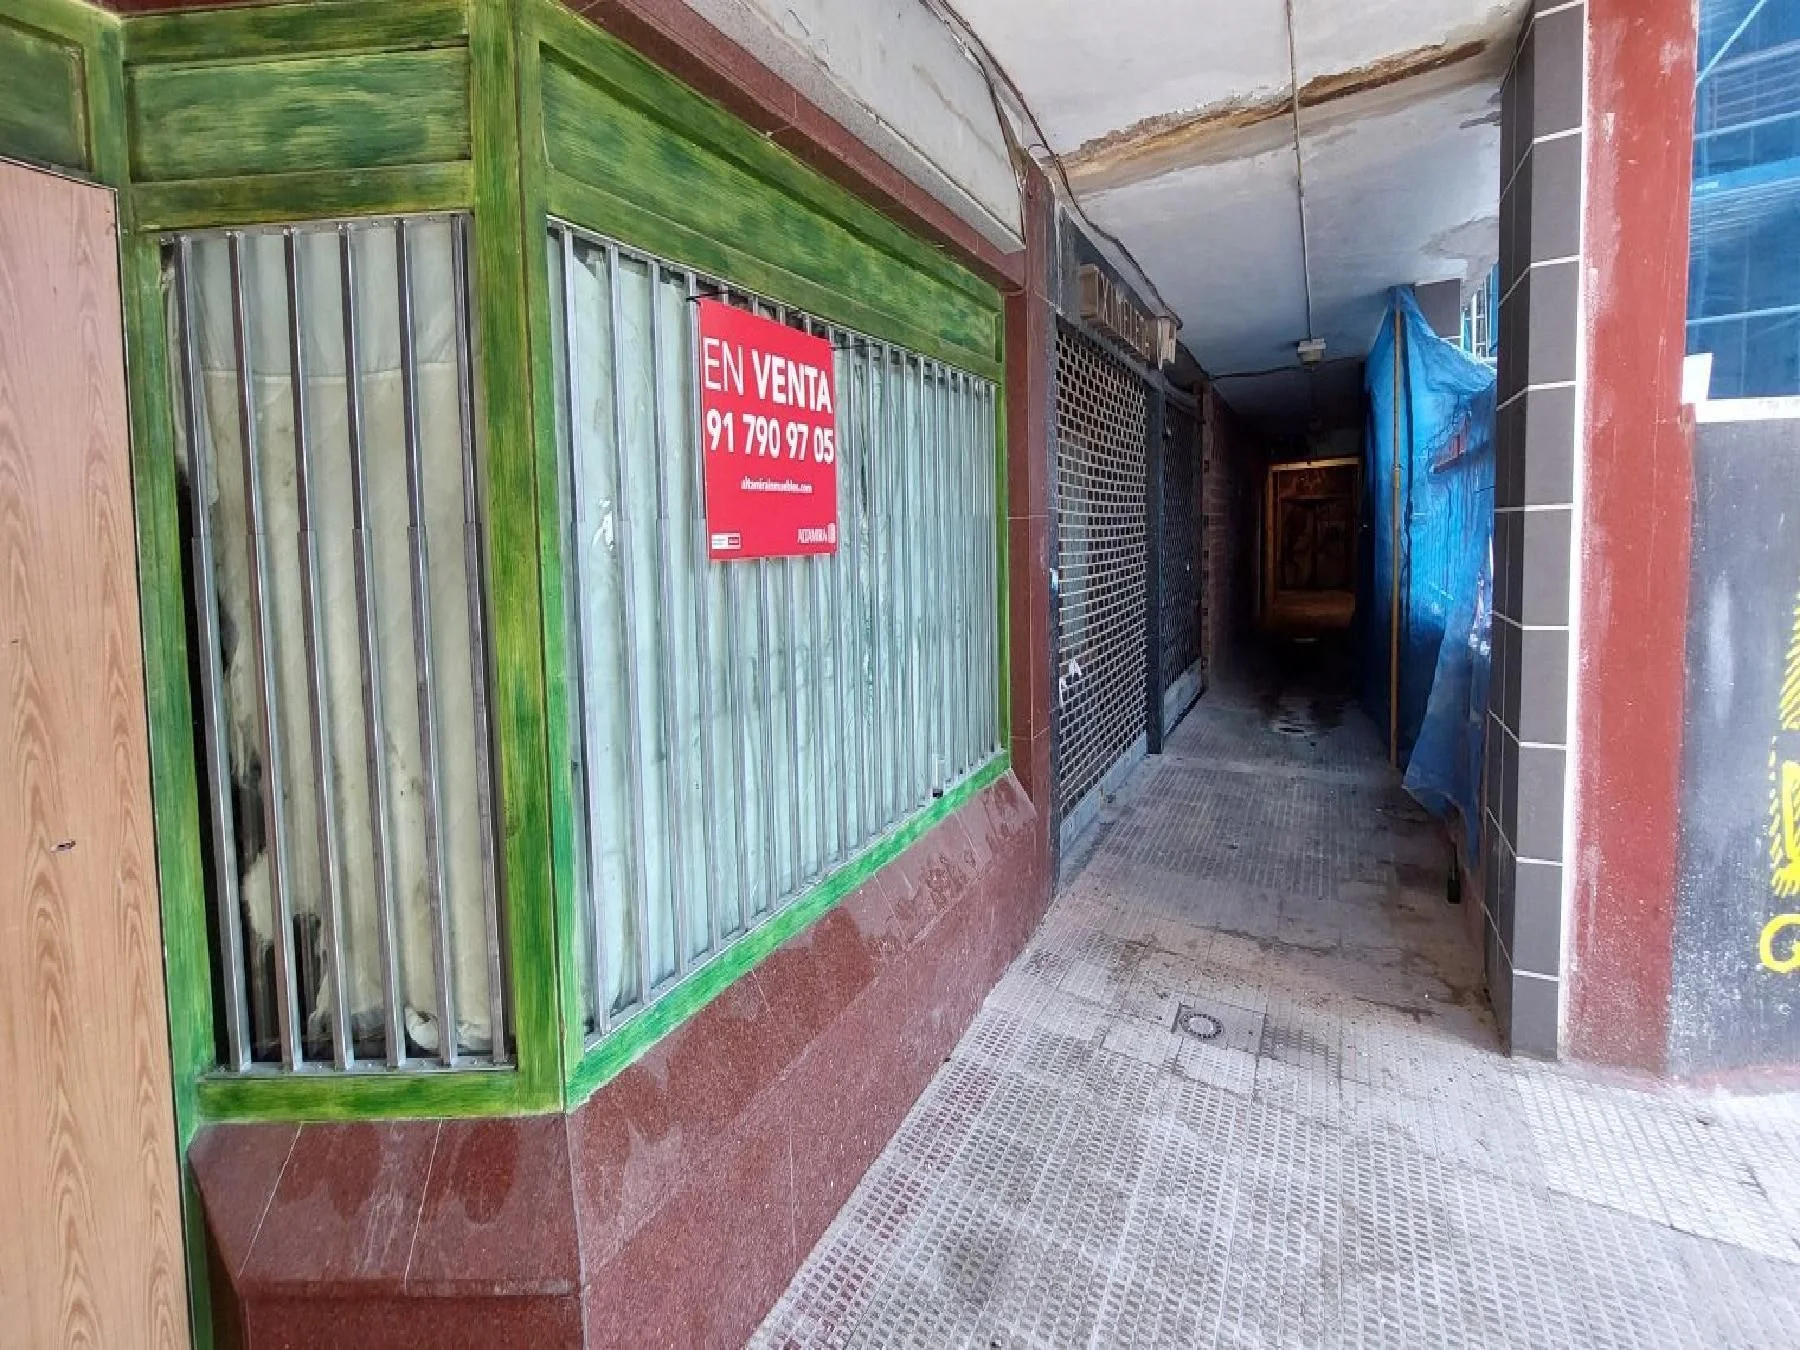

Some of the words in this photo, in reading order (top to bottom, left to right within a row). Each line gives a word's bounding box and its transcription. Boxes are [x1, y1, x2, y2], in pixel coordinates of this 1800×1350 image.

[703, 337, 744, 396] EN
[752, 348, 833, 414] VENTA
[706, 408, 734, 453] 91
[742, 412, 781, 459] 790
[786, 421, 809, 460] 97
[814, 425, 834, 465] 05
